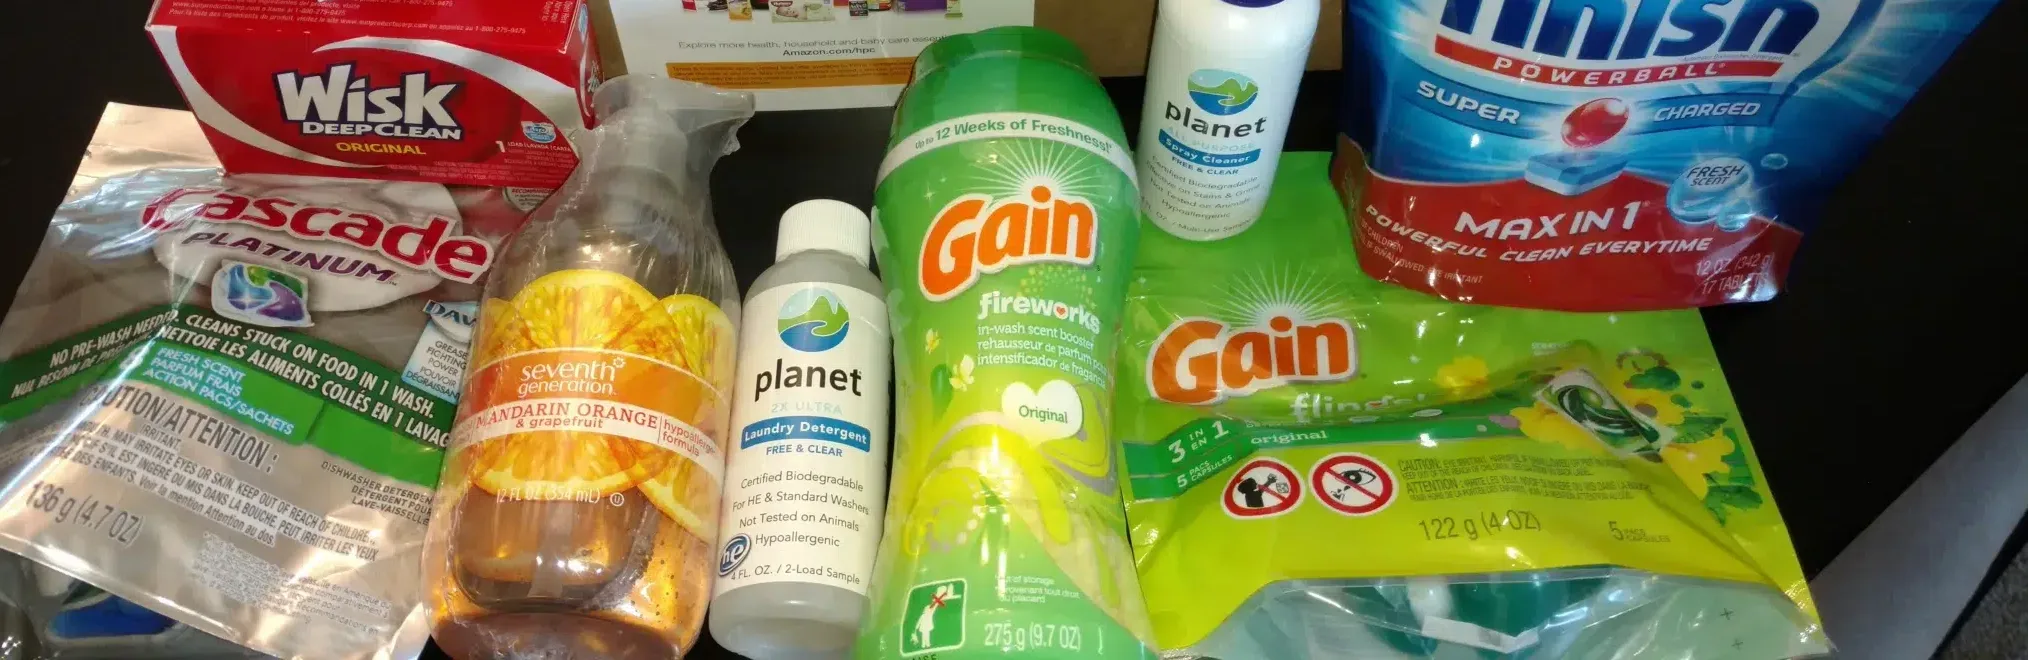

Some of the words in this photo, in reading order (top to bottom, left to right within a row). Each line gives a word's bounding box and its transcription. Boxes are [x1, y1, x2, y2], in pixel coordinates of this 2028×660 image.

[678, 41, 716, 50] Explore
[747, 41, 781, 49] health,
[784, 39, 836, 48] household
[839, 38, 858, 46] and
[861, 37, 886, 46] baby
[782, 47, 876, 57] Amazon.com/hpc
[1493, 56, 1721, 86] POWERBALL
[276, 63, 458, 127] Wisk
[1416, 79, 1521, 126] SUPER
[1653, 101, 1762, 123] CHARGED
[1165, 101, 1267, 138] planet
[915, 138, 926, 150] Up
[926, 136, 934, 146] to
[936, 127, 951, 142] 12
[953, 118, 1006, 136] Weeks
[1010, 118, 1028, 131] of
[335, 142, 427, 155] ORIGINAL
[1165, 138, 1200, 160] Spray
[1202, 153, 1251, 164] Cleaner
[1171, 156, 1194, 172] FREE
[1686, 164, 1746, 179] FRESH
[1690, 175, 1731, 188] SCENT
[142, 187, 489, 279] Cascade
[1365, 204, 1488, 258] POWERFUL
[1499, 243, 1572, 262] CLEAN
[1578, 236, 1714, 257] EVERYTIME
[1454, 209, 1564, 241] MAX
[1568, 204, 1611, 236] IN
[1619, 201, 1644, 232] 1
[920, 184, 1096, 298] Gain
[1696, 259, 1710, 276] 12
[1713, 257, 1732, 275] OZ
[1702, 279, 1717, 295] 17
[977, 290, 1100, 335] fireworks
[978, 322, 1026, 336] in-wash
[1027, 324, 1059, 339] scent
[1060, 326, 1094, 349] booster
[427, 347, 467, 370] FIGHTING
[435, 341, 469, 360] GREASE
[977, 339, 1043, 351] rehausseur
[1058, 343, 1092, 366] parfum
[977, 353, 1058, 369] intensificador
[1150, 314, 1351, 405] Gain
[50, 348, 69, 368] NO
[70, 325, 133, 361] PRE-WASH
[185, 314, 242, 338] CLEANS
[243, 328, 293, 354] STUCK
[293, 343, 317, 364] ON
[317, 353, 359, 381] FOOD
[359, 371, 379, 391] IN
[379, 379, 390, 396] 1
[391, 387, 435, 419] WASH.
[151, 356, 206, 383] PARFUM
[205, 374, 242, 397] FRAIS
[157, 346, 201, 365] FRESH
[203, 358, 246, 383] SCENT
[420, 366, 457, 388] POUVOIR
[429, 358, 459, 377] POWER
[519, 357, 616, 382] seventh
[11, 383, 36, 399] NUL
[159, 325, 220, 351] NETTOIE
[220, 339, 248, 359] LES
[247, 349, 321, 390] ALIMENTS
[321, 380, 372, 414] COLLÉS
[371, 401, 394, 423] EN
[393, 411, 405, 429] 1
[405, 415, 449, 448] LAVAG
[755, 358, 862, 402] planet
[143, 367, 200, 392] ACTION
[199, 386, 296, 436] PACS/SACHETS
[771, 403, 788, 414] 2X
[795, 402, 843, 415] ULTRA
[1018, 404, 1069, 424] Original
[80, 383, 271, 472] CUTION/ATTENTION
[475, 402, 571, 429] MANDARIN
[577, 402, 658, 429] ORANGE
[515, 419, 525, 429] &
[529, 415, 604, 431] grapefruit
[141, 423, 182, 451] IRRITANT.
[662, 430, 700, 457] formula
[744, 422, 795, 442] Laundry
[799, 421, 868, 445] Detergent
[1168, 439, 1187, 464] 3
[1189, 428, 1205, 442] IN
[1210, 421, 1230, 440] 1
[1250, 430, 1328, 447] original
[766, 444, 792, 456] FREE
[796, 444, 804, 453] &
[807, 444, 843, 457] CLEAR
[113, 428, 136, 446] MAY
[135, 437, 176, 464] IRRITATE
[173, 456, 197, 475] EYES
[197, 466, 211, 481] OR
[211, 472, 234, 491] SKIN.
[235, 483, 260, 500] KEEP
[259, 493, 280, 508] OUT
[278, 501, 291, 514] OF
[290, 507, 319, 528] REACH
[319, 516, 333, 532] OF
[741, 471, 783, 490] Certified
[786, 471, 864, 492] Biodegradable
[1177, 474, 1189, 489] 5
[1189, 460, 1211, 476] PACS
[1191, 454, 1234, 483] CAPSULES
[321, 460, 382, 492] DISHWASHER
[382, 485, 433, 505] DETERGEN
[1406, 478, 1459, 495] ATTENTION
[26, 480, 64, 512] 136
[55, 498, 76, 523] g
[72, 495, 114, 531] (4.7
[108, 511, 145, 545] OZ)
[351, 485, 409, 509] DETERGENT
[408, 501, 433, 517] POUR
[351, 496, 430, 526] LAVE-VAISSELLE
[732, 499, 746, 513] For
[747, 493, 762, 506] HE
[764, 492, 773, 503] &
[776, 491, 828, 503] Standard
[830, 494, 870, 516] Washers
[739, 515, 757, 529] Not
[760, 511, 798, 524] Tested
[801, 513, 816, 522] on
[819, 512, 860, 532] Animals
[1419, 516, 1456, 541] 122
[1463, 522, 1479, 542] g
[1481, 512, 1501, 536] (4
[755, 531, 841, 548] Hypoallergenic
[738, 568, 751, 580] FL.
[754, 565, 773, 576] OZ.
[785, 563, 823, 576] 2-Load
[826, 566, 861, 585] Sample
[984, 623, 1012, 647] 275
[1015, 627, 1026, 652] g
[1029, 622, 1056, 649] (9.7
[1059, 624, 1082, 652] OZ)
